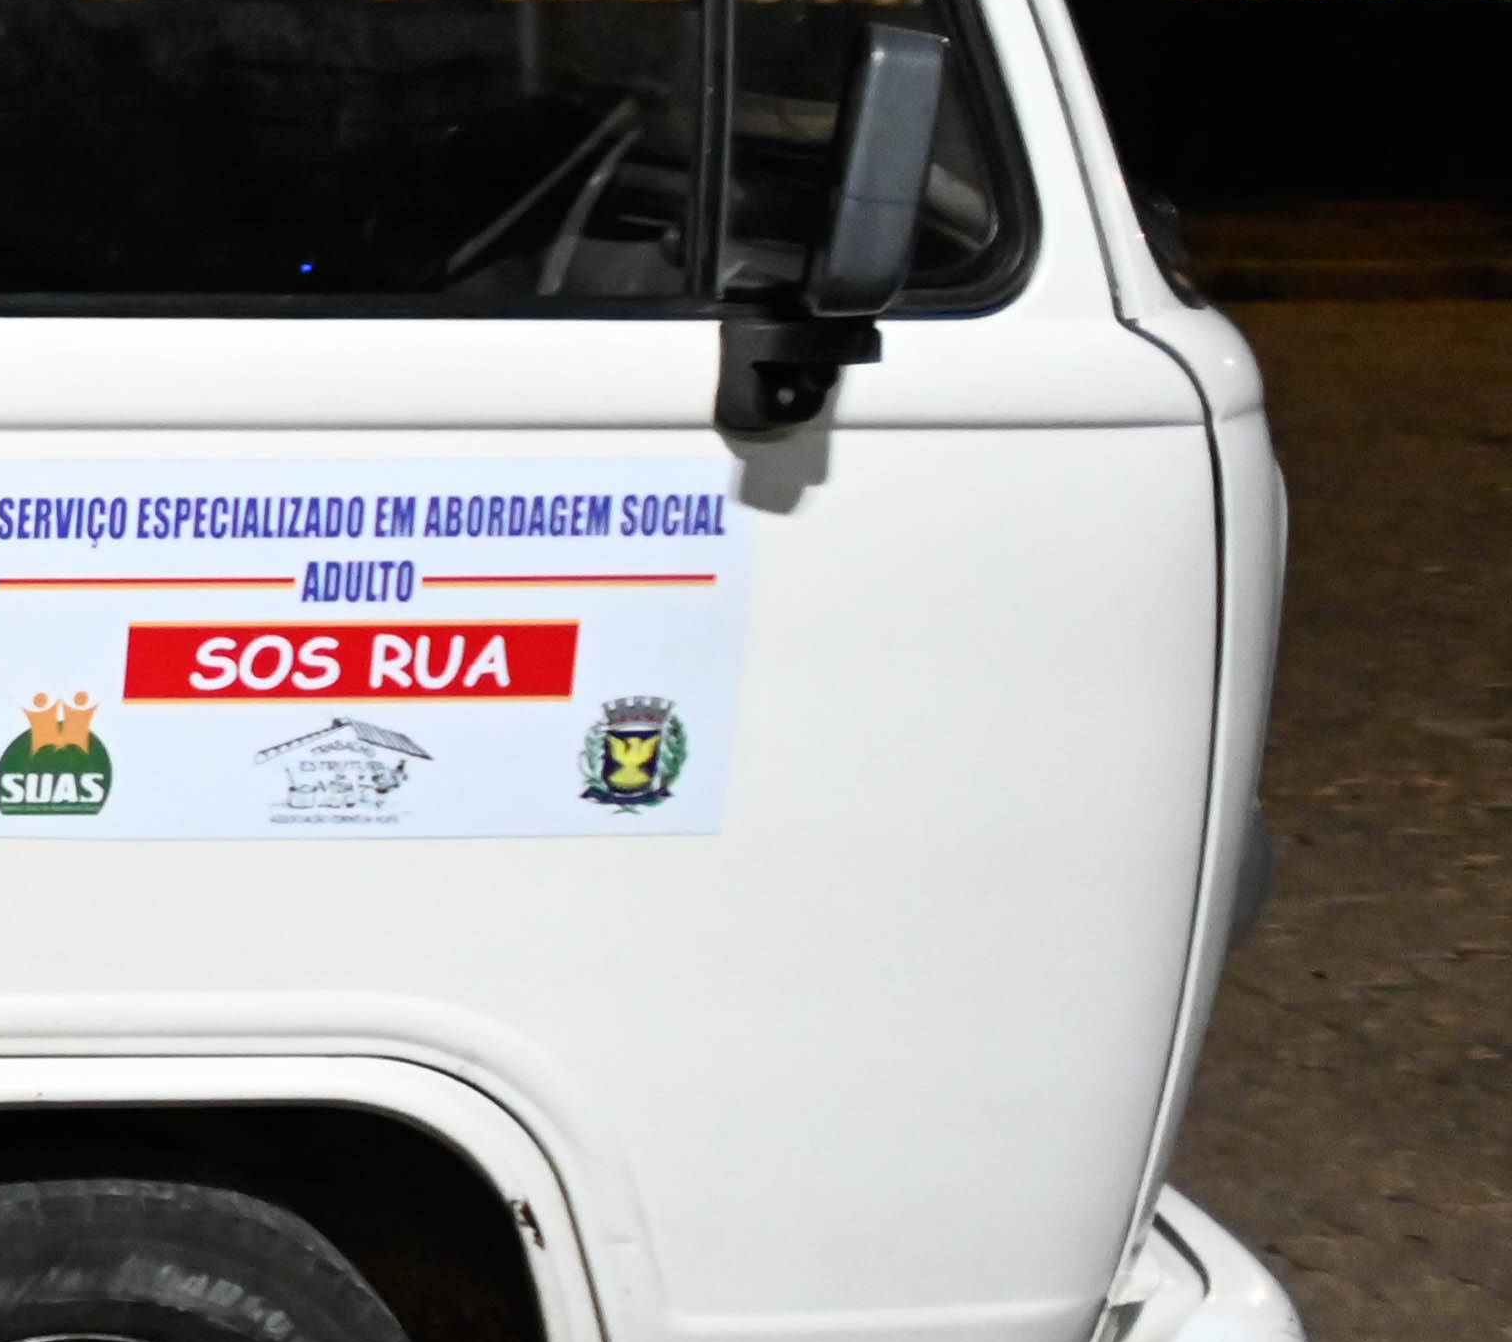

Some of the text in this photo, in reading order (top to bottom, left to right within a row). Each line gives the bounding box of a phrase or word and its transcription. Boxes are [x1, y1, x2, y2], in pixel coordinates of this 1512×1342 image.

[136, 495, 365, 540] ESPECIALIZADO
[374, 495, 416, 538] EM
[423, 493, 612, 538] ABORDAGEM
[619, 493, 727, 537] SOCIAL
[301, 560, 414, 604] ADULTO
[189, 634, 512, 691] SOS RUA
[0, 771, 105, 804] SUAS
